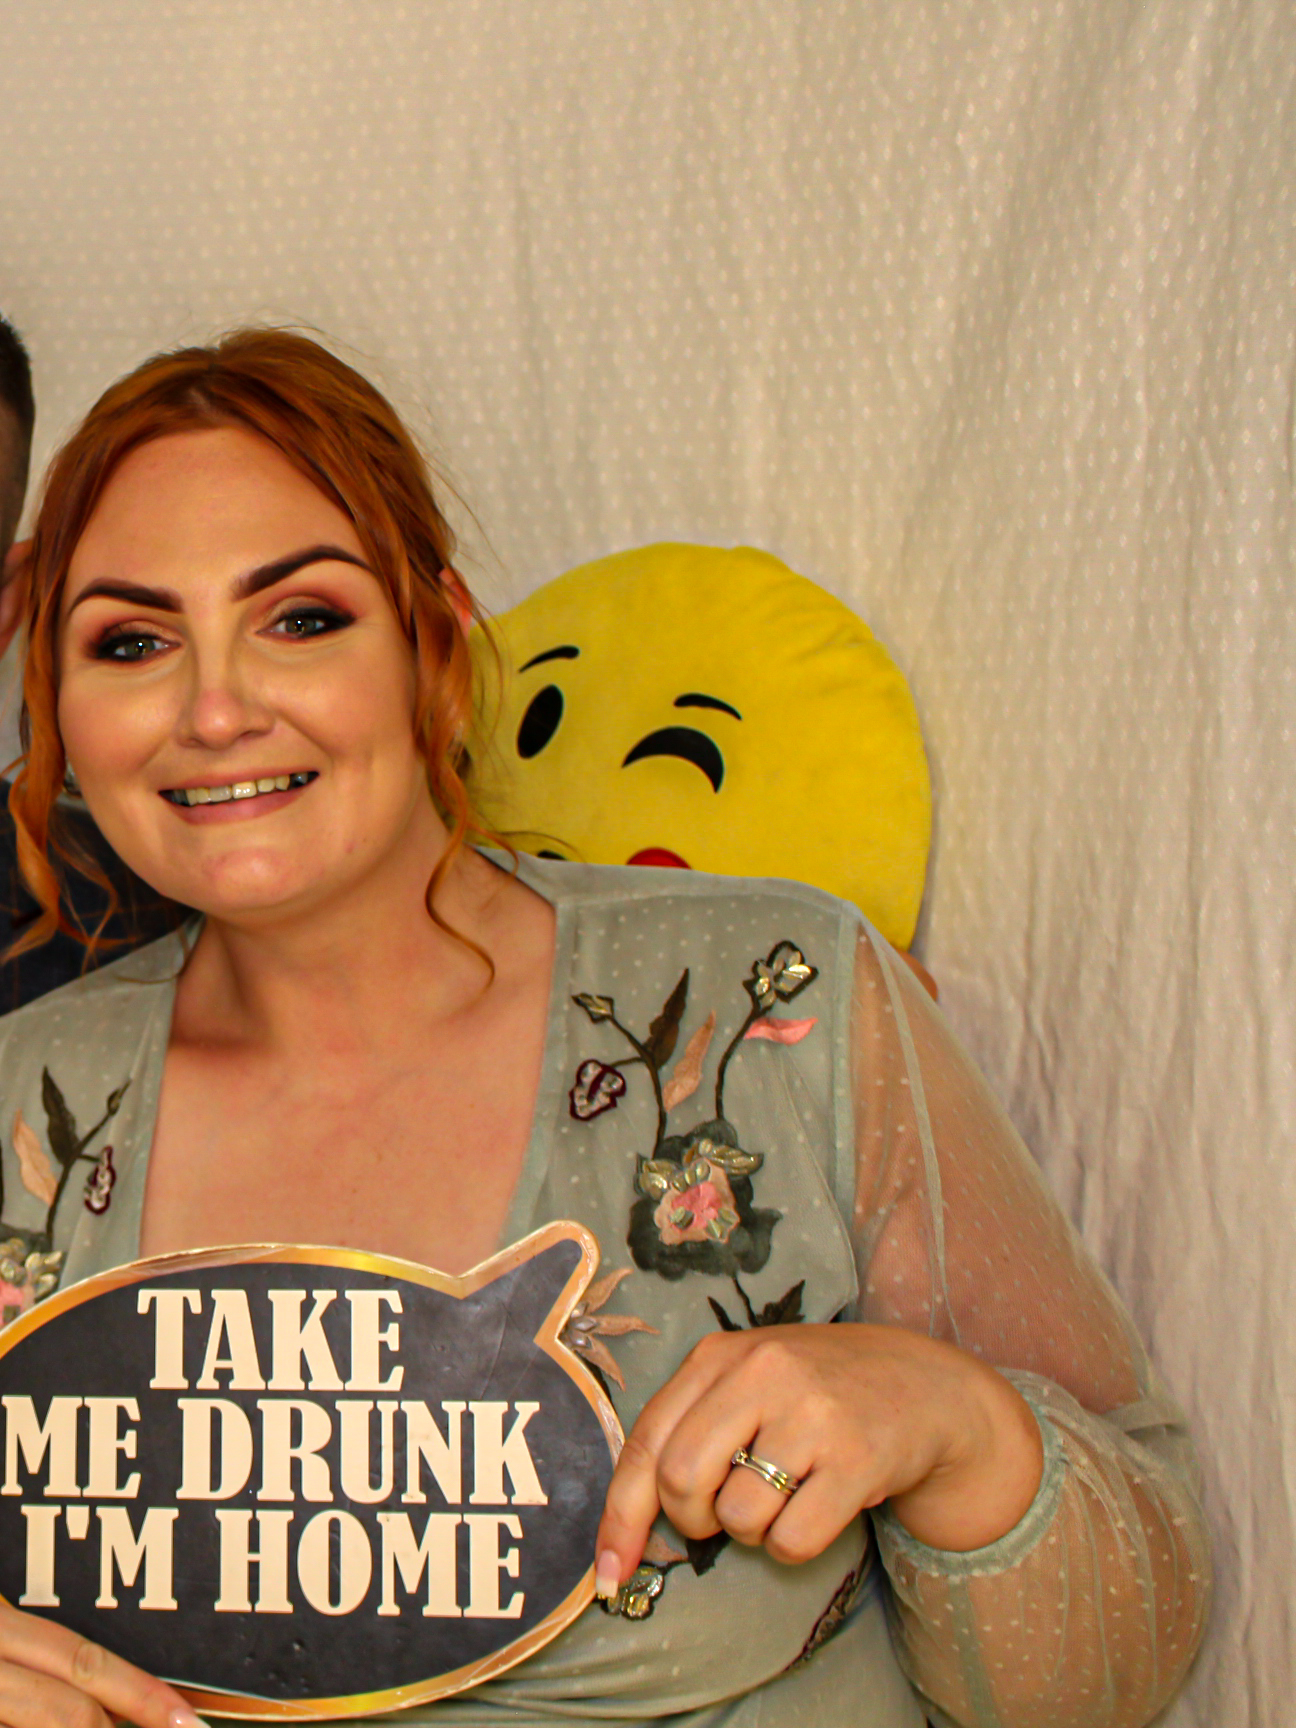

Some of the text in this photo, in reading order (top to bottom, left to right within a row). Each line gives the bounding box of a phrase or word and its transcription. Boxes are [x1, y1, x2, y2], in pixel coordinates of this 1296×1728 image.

[137, 1288, 405, 1392] TAKE
[0, 1395, 548, 1506] ME DRUNK
[19, 1505, 525, 1618] I'M HOME
